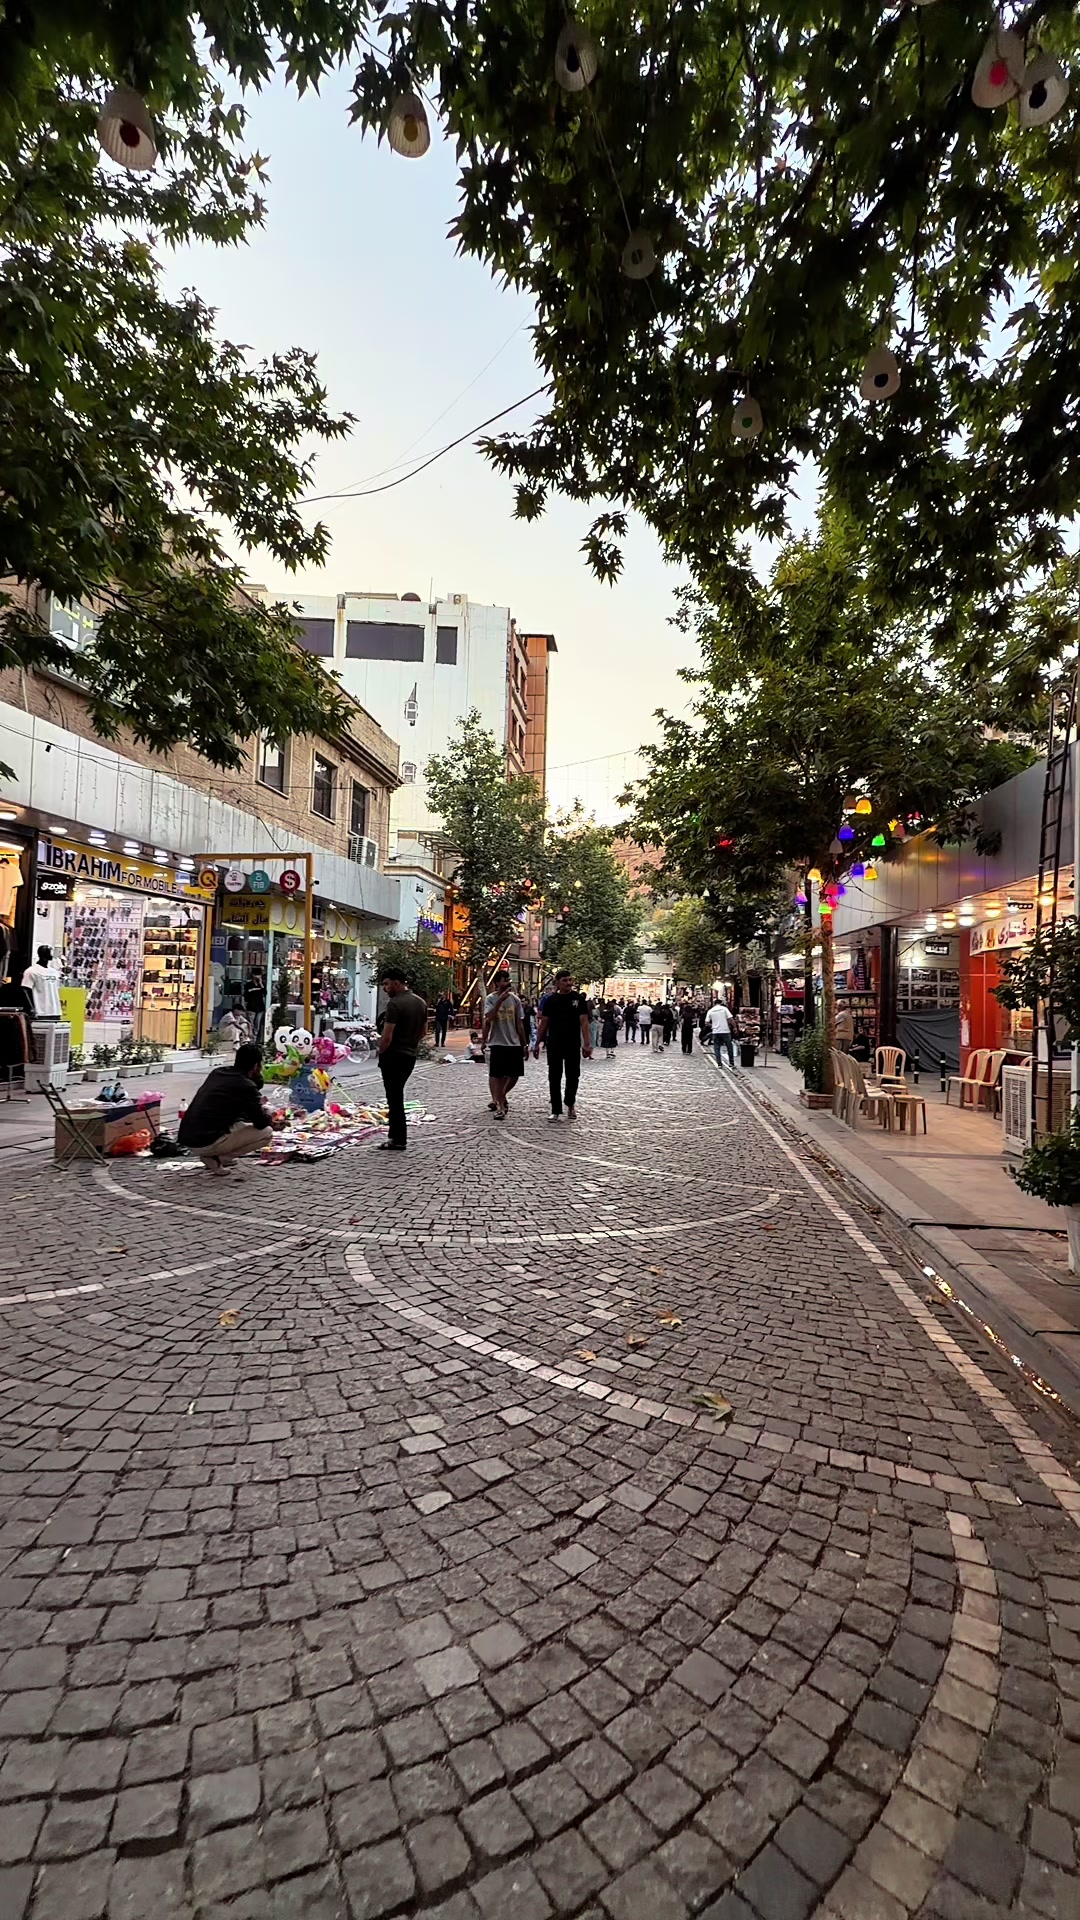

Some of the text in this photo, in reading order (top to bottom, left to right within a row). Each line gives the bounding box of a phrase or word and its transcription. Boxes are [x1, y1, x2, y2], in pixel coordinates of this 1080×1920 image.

[121, 871, 142, 887] FOR
[143, 876, 177, 894] MOBILE
[253, 881, 265, 889] FIB
